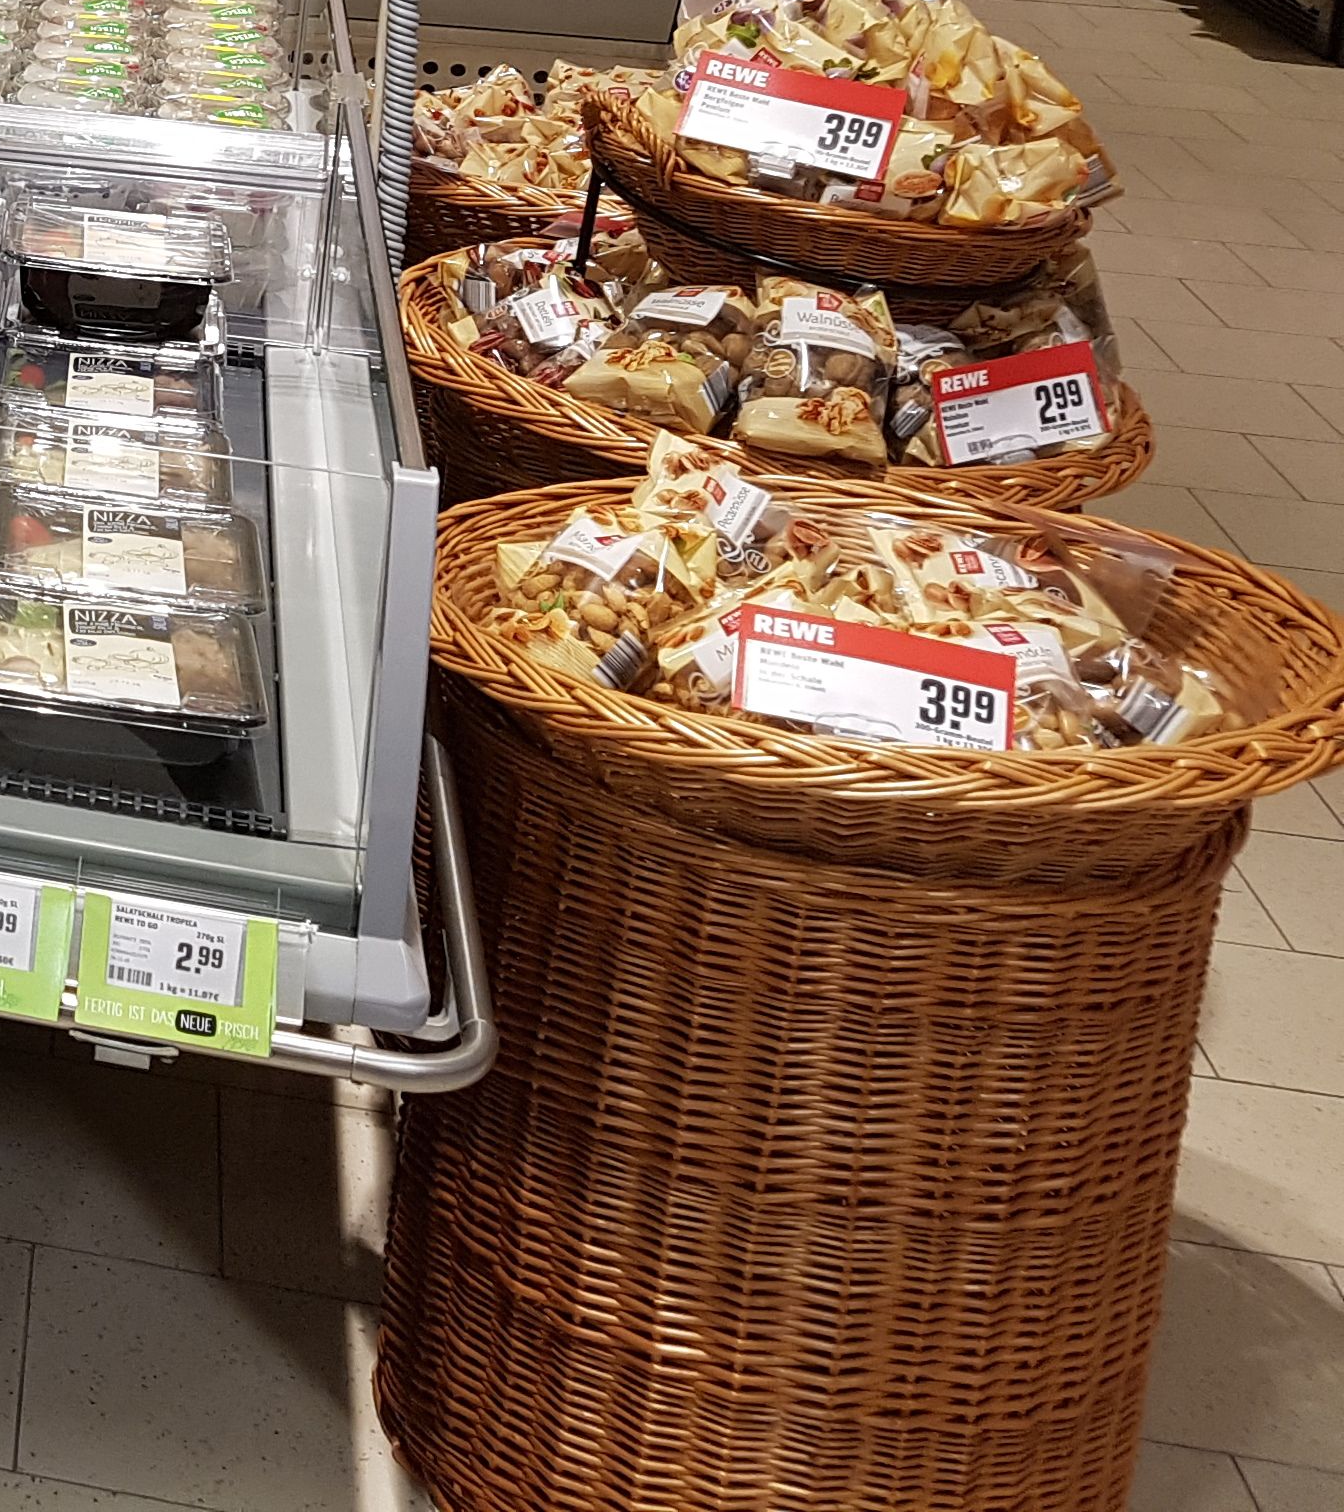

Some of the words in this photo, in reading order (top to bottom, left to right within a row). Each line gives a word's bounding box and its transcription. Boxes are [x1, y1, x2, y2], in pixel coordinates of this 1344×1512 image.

[706, 60, 770, 87] REWE
[818, 113, 883, 153] 3.99
[77, 355, 127, 370] NIZZA
[940, 370, 989, 394] REWE
[1036, 380, 1084, 424] 2.99
[93, 510, 152, 525] NIZZA
[74, 609, 137, 626] NIZZA
[754, 614, 835, 646] REWE
[919, 678, 995, 730] 3.99
[116, 905, 164, 921] SALATSCHALE
[166, 916, 198, 928] TROPICA
[136, 919, 146, 927] TO
[148, 920, 158, 929] GO
[175, 942, 224, 974] 2.99
[85, 996, 122, 1017] FERTIG
[129, 1001, 145, 1021] IST
[151, 1008, 175, 1026] DAS
[180, 1014, 213, 1034] NEUE
